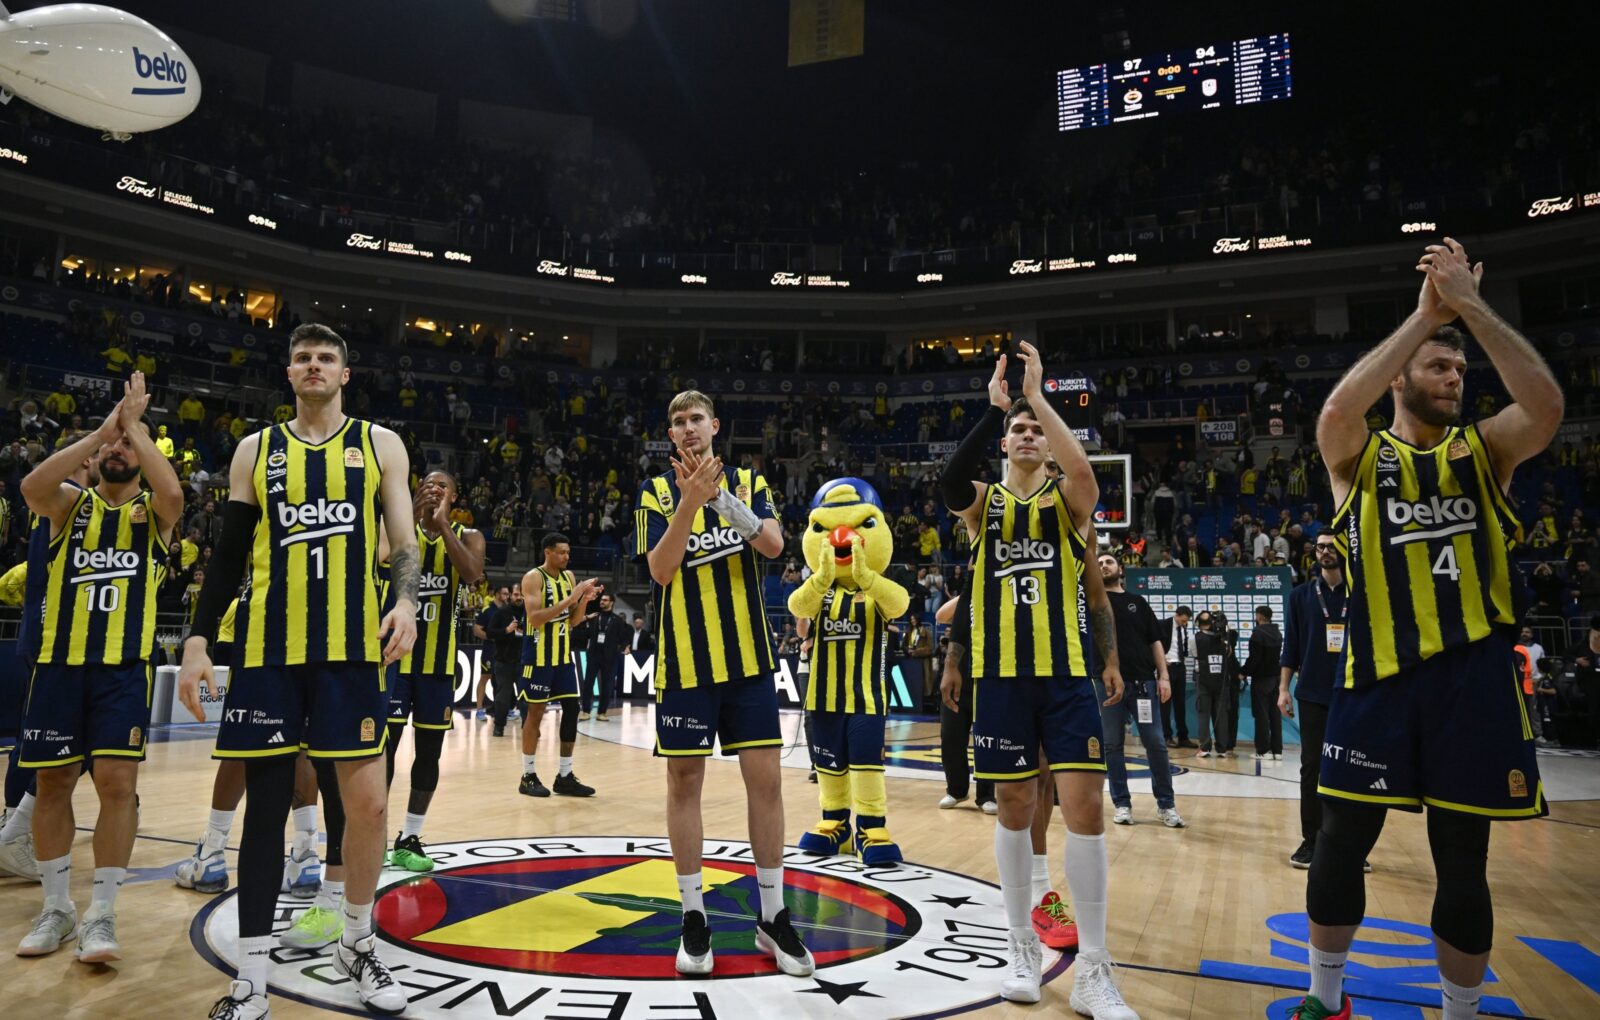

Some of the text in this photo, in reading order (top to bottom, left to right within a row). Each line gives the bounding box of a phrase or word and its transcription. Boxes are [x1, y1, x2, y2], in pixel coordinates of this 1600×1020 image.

[1195, 45, 1216, 59] 94
[132, 46, 187, 84] beko
[1123, 58, 1142, 71] 97
[1157, 64, 1181, 76] 0:00
[116, 176, 156, 198] Ford
[1527, 196, 1574, 218] Ford
[346, 233, 382, 250] Ford
[1212, 237, 1251, 254] Ford
[536, 260, 568, 276] Ford
[1009, 259, 1043, 275] Ford
[770, 272, 802, 286] Ford
[1079, 393, 1089, 406] 0
[1213, 423, 1234, 431] 208
[1214, 432, 1234, 441] 108
[938, 444, 957, 452] 209
[267, 467, 287, 476] beko
[1377, 461, 1400, 470] beko
[277, 498, 357, 527] beko
[1386, 495, 1477, 525] beko
[73, 546, 140, 569] beko
[994, 538, 1055, 562] beko
[310, 546, 324, 579] 1
[1431, 545, 1460, 581] 4
[418, 572, 449, 589] eko
[84, 584, 120, 612] 10
[1007, 576, 1041, 605] 13
[415, 601, 437, 622] 20
[1077, 584, 1088, 634] ACADEMY
[823, 616, 862, 634] beko
[529, 683, 543, 692] YKT
[225, 708, 247, 723] KT
[252, 717, 284, 725] Kiralama
[253, 710, 267, 718] Filo
[661, 715, 683, 728] YKT
[974, 734, 995, 749] YKT
[1350, 749, 1366, 759] Filo
[1349, 757, 1388, 770] Kiralama
[429, 841, 587, 865] POR
[896, 919, 1010, 981] 1907
